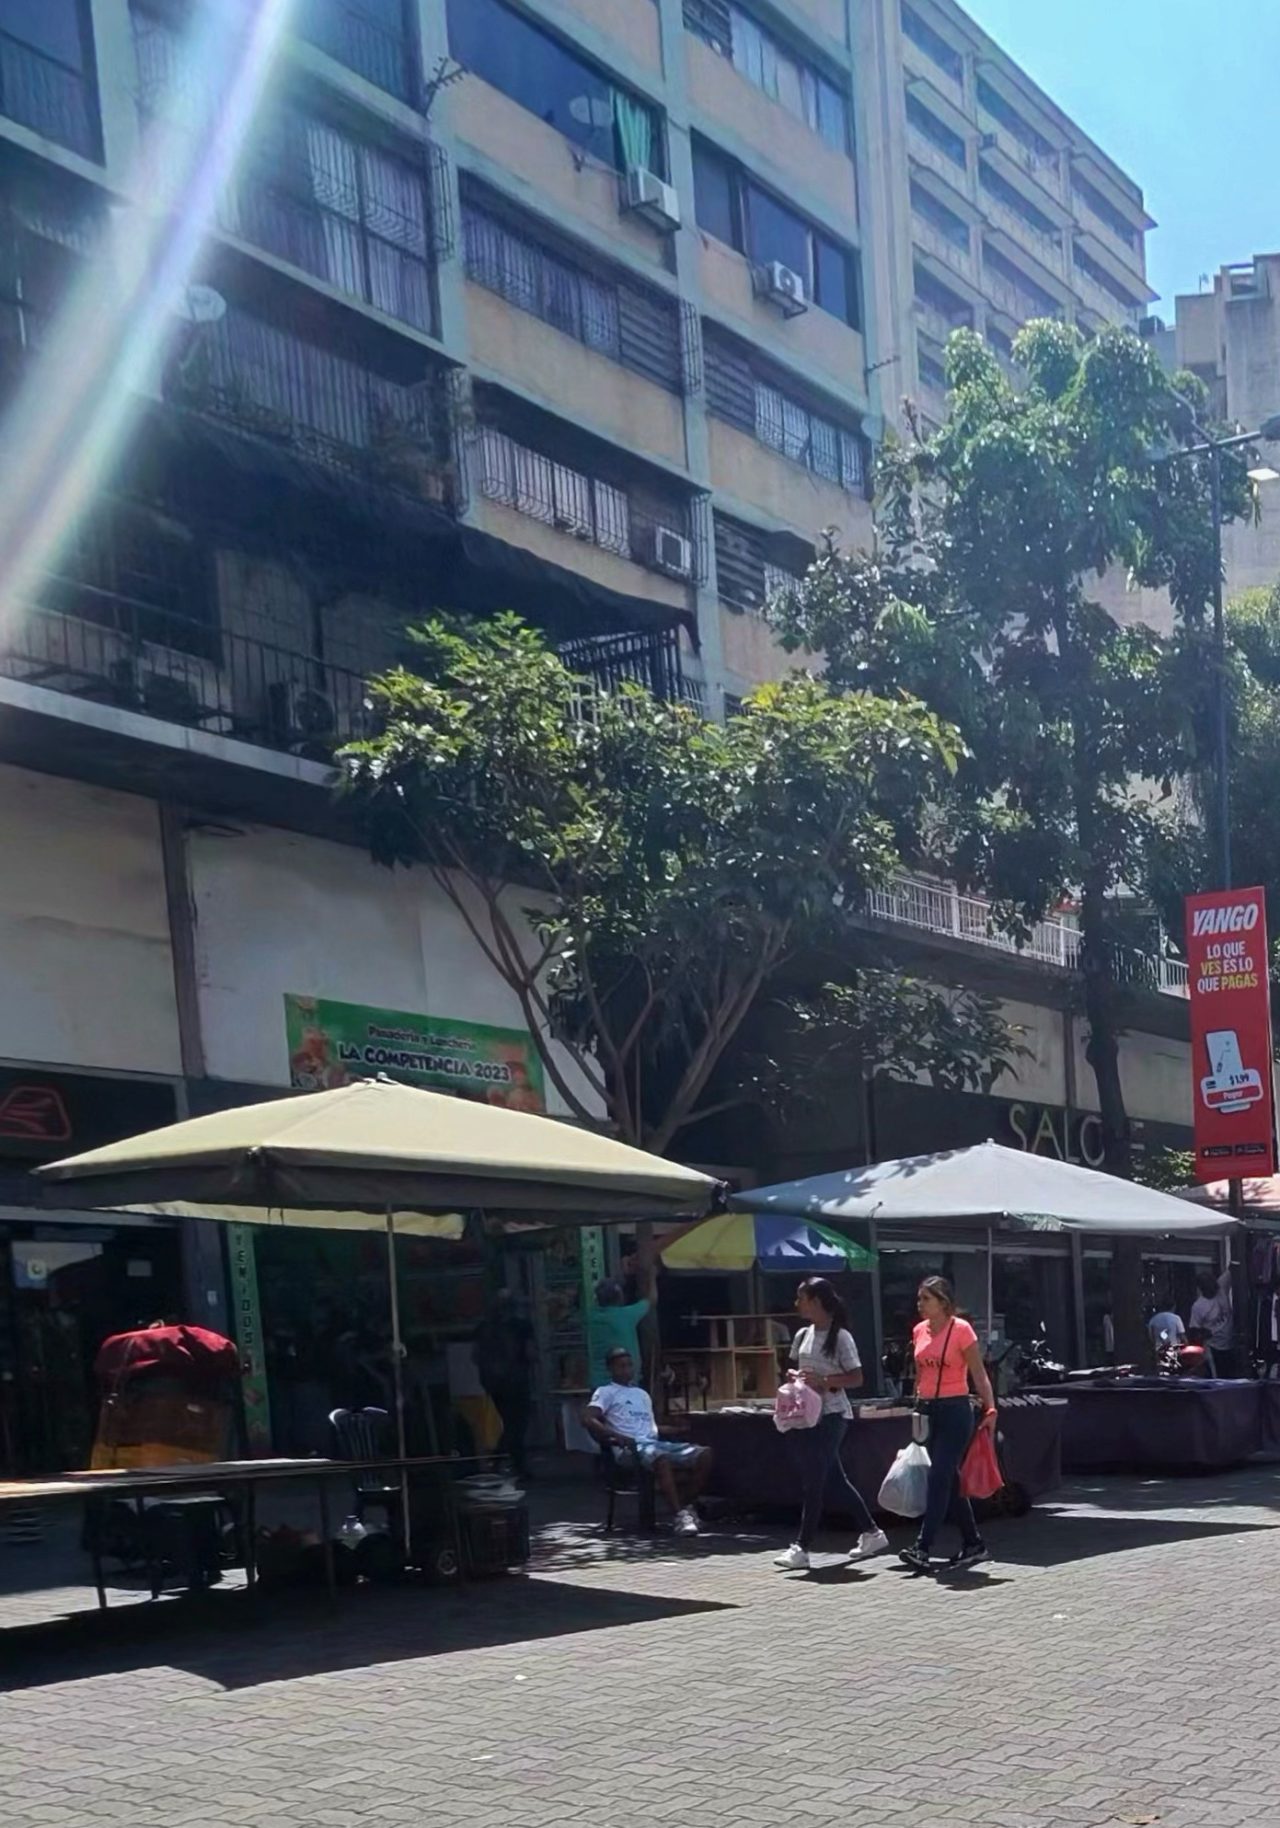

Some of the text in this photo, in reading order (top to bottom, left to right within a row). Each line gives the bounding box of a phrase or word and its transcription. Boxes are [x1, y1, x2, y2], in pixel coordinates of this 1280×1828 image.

[1192, 903, 1259, 936] YANGO
[1207, 941, 1246, 959] LO QUE
[1200, 956, 1253, 976] VES ES LO
[1197, 973, 1258, 993] QUE PAGAS
[338, 1044, 510, 1081] LA COMPETENCIA 2023
